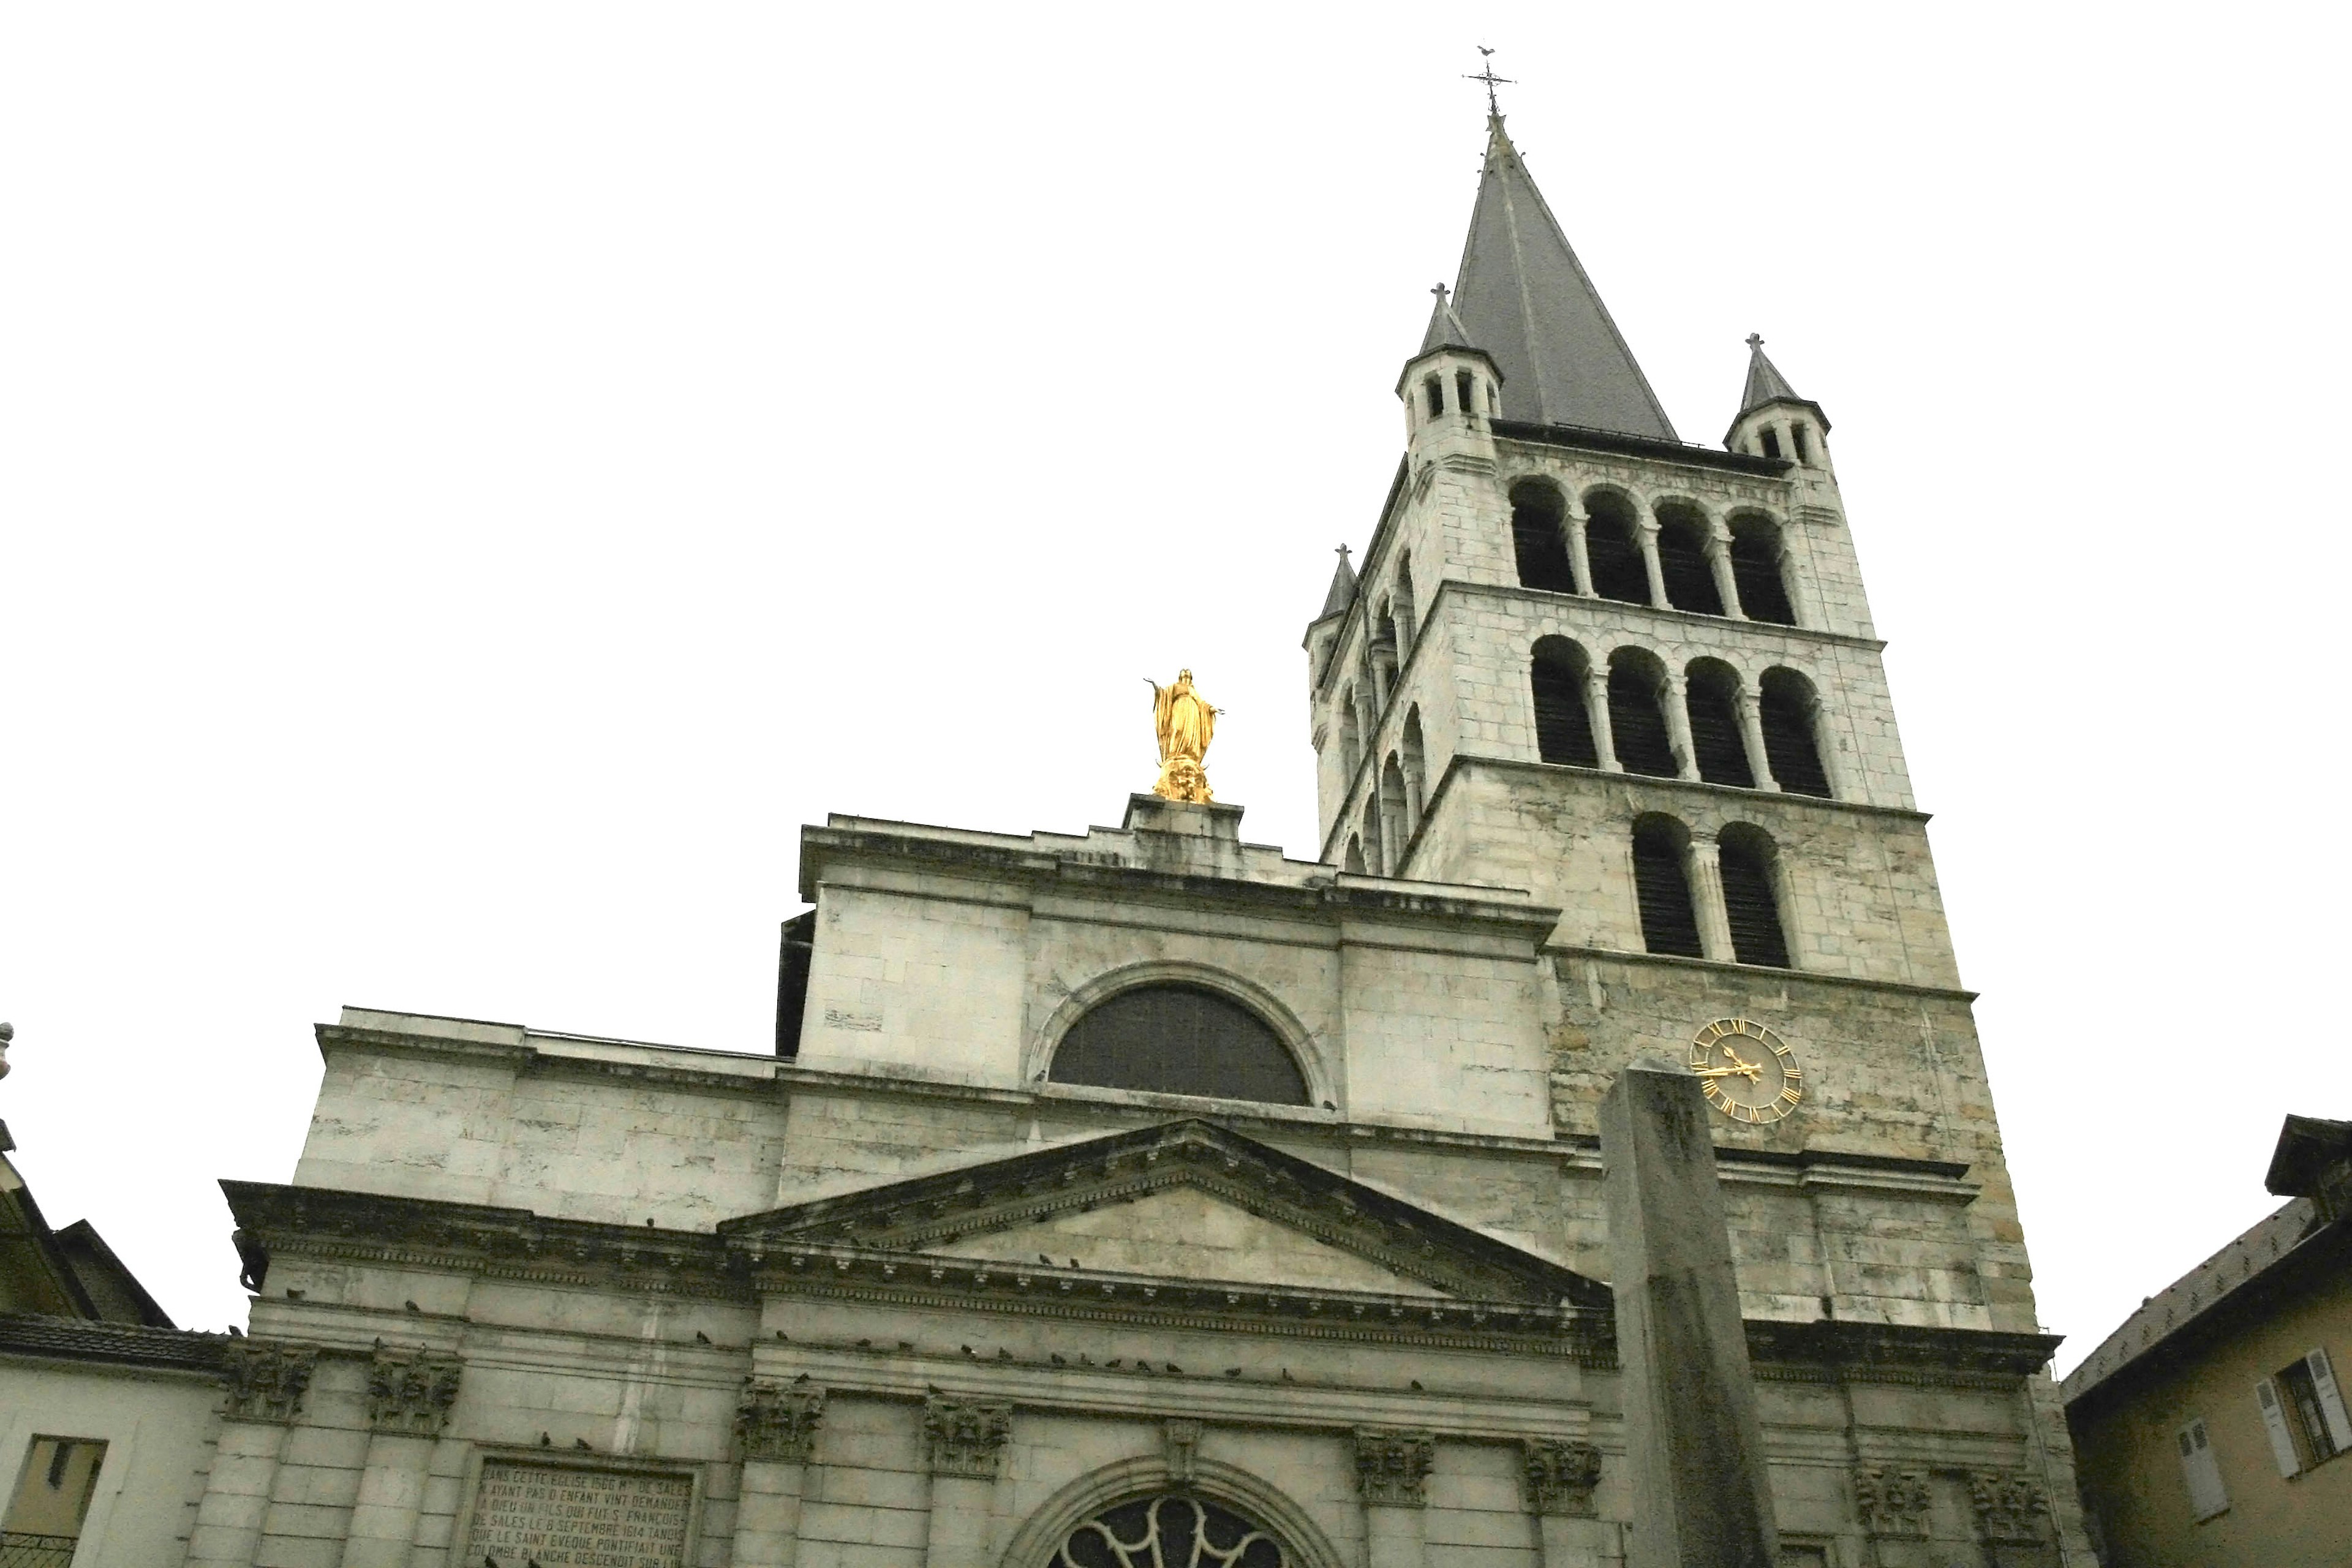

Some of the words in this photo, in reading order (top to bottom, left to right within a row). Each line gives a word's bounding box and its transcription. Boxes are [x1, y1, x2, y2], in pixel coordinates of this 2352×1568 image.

[513, 1471, 548, 1485] CETTE
[551, 1474, 587, 1489] EGLISE
[656, 1481, 693, 1498] SALES
[491, 1499, 518, 1512] DIEU
[521, 1502, 534, 1513] UN
[567, 1506, 585, 1518] QUI
[587, 1507, 609, 1520] FUT
[526, 1487, 546, 1499] PAS
[605, 1493, 628, 1506] VINT
[632, 1496, 692, 1512] DEMANDER
[473, 1513, 486, 1526] DE
[490, 1515, 526, 1529] SALES
[529, 1518, 543, 1531] LE
[546, 1520, 554, 1531] 8
[556, 1520, 620, 1536] SEPTEMBRE
[647, 1527, 685, 1542] TANDIS
[467, 1544, 518, 1559] COLOMBE
[521, 1547, 571, 1563] BLANCHE
[574, 1553, 635, 1567] DESCENDIT
[472, 1529, 493, 1542] QUE
[497, 1531, 511, 1543] LE
[514, 1532, 547, 1546] SAINT
[550, 1535, 592, 1550] EVEQUE
[596, 1539, 655, 1554] PONTIFIAIT
[659, 1544, 682, 1556] UNE
